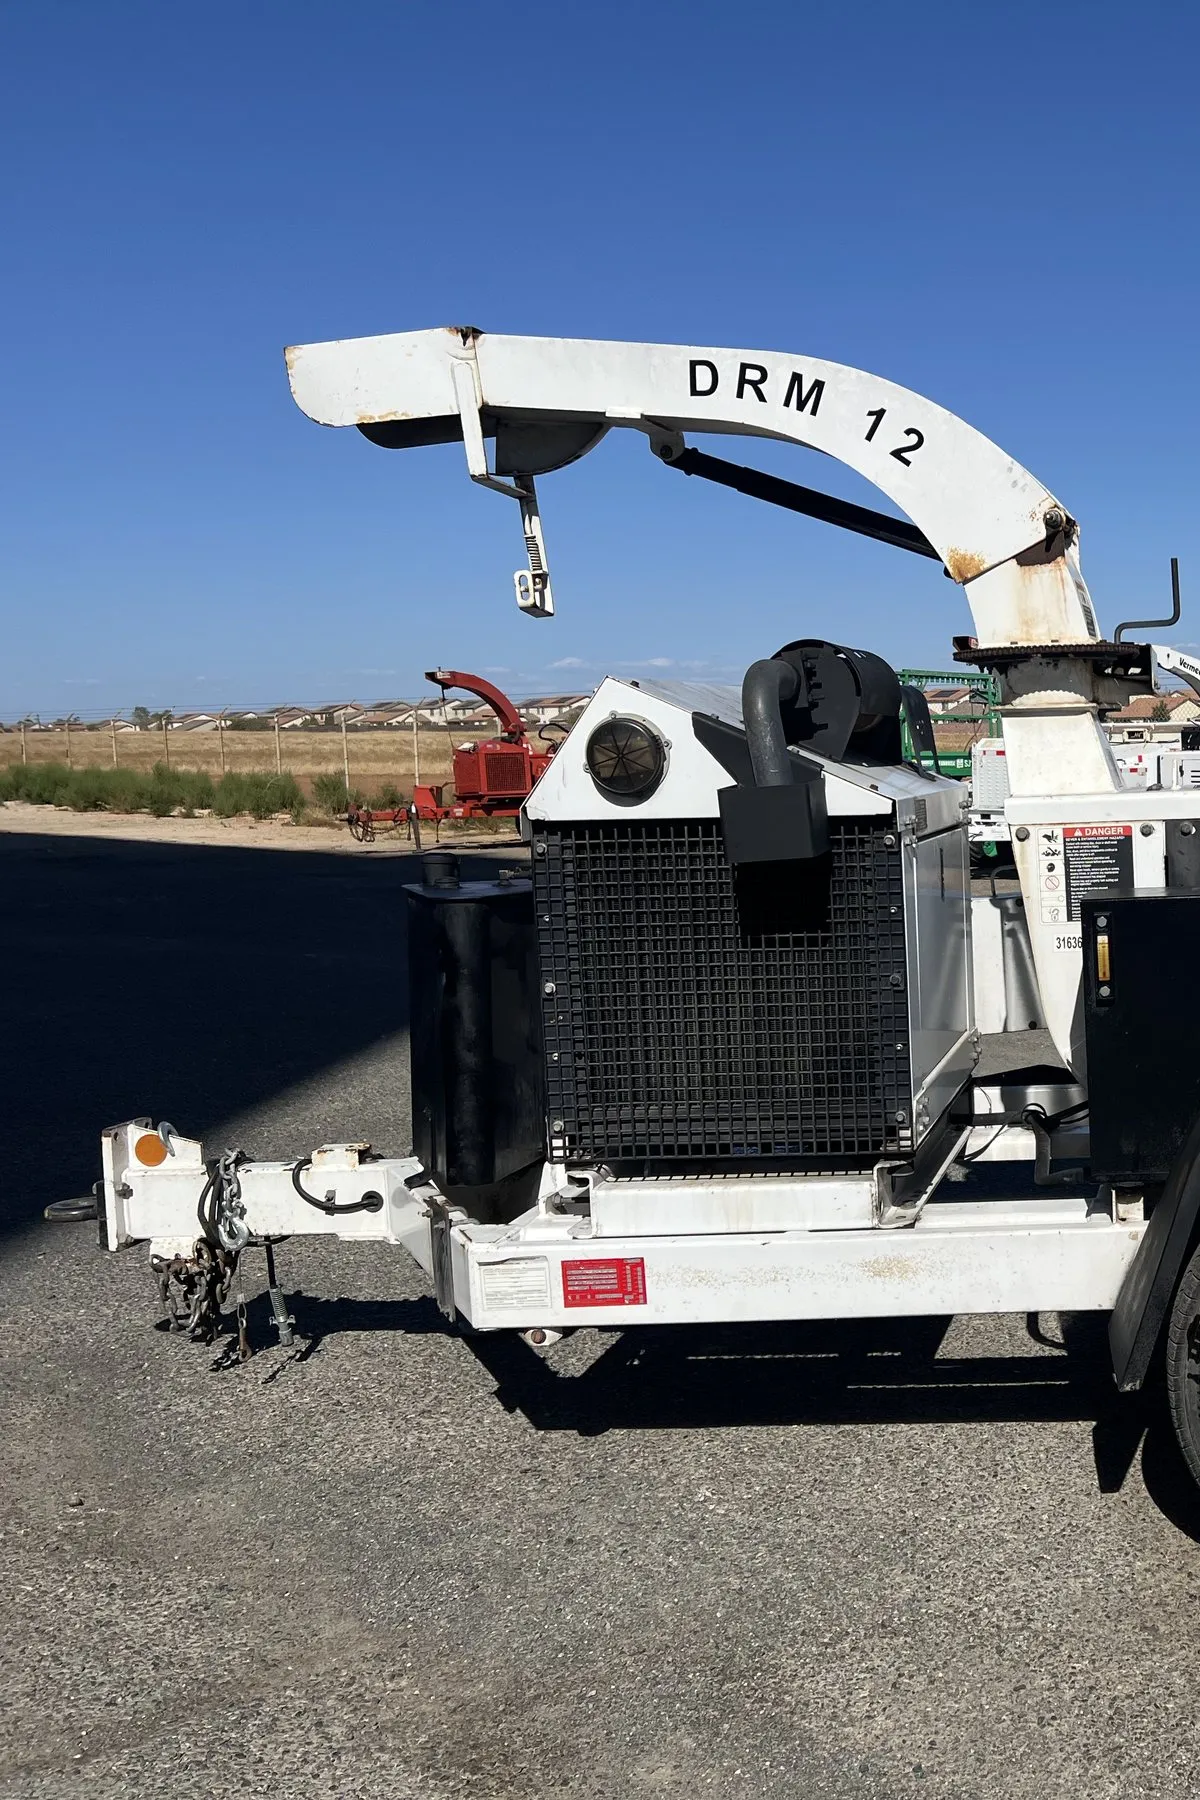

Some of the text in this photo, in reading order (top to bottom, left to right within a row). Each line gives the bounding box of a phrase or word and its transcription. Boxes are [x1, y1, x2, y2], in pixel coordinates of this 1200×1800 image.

[689, 359, 925, 467] DRM 12
[1085, 827, 1124, 836] DANGER
[1056, 937, 1083, 949] 31636
